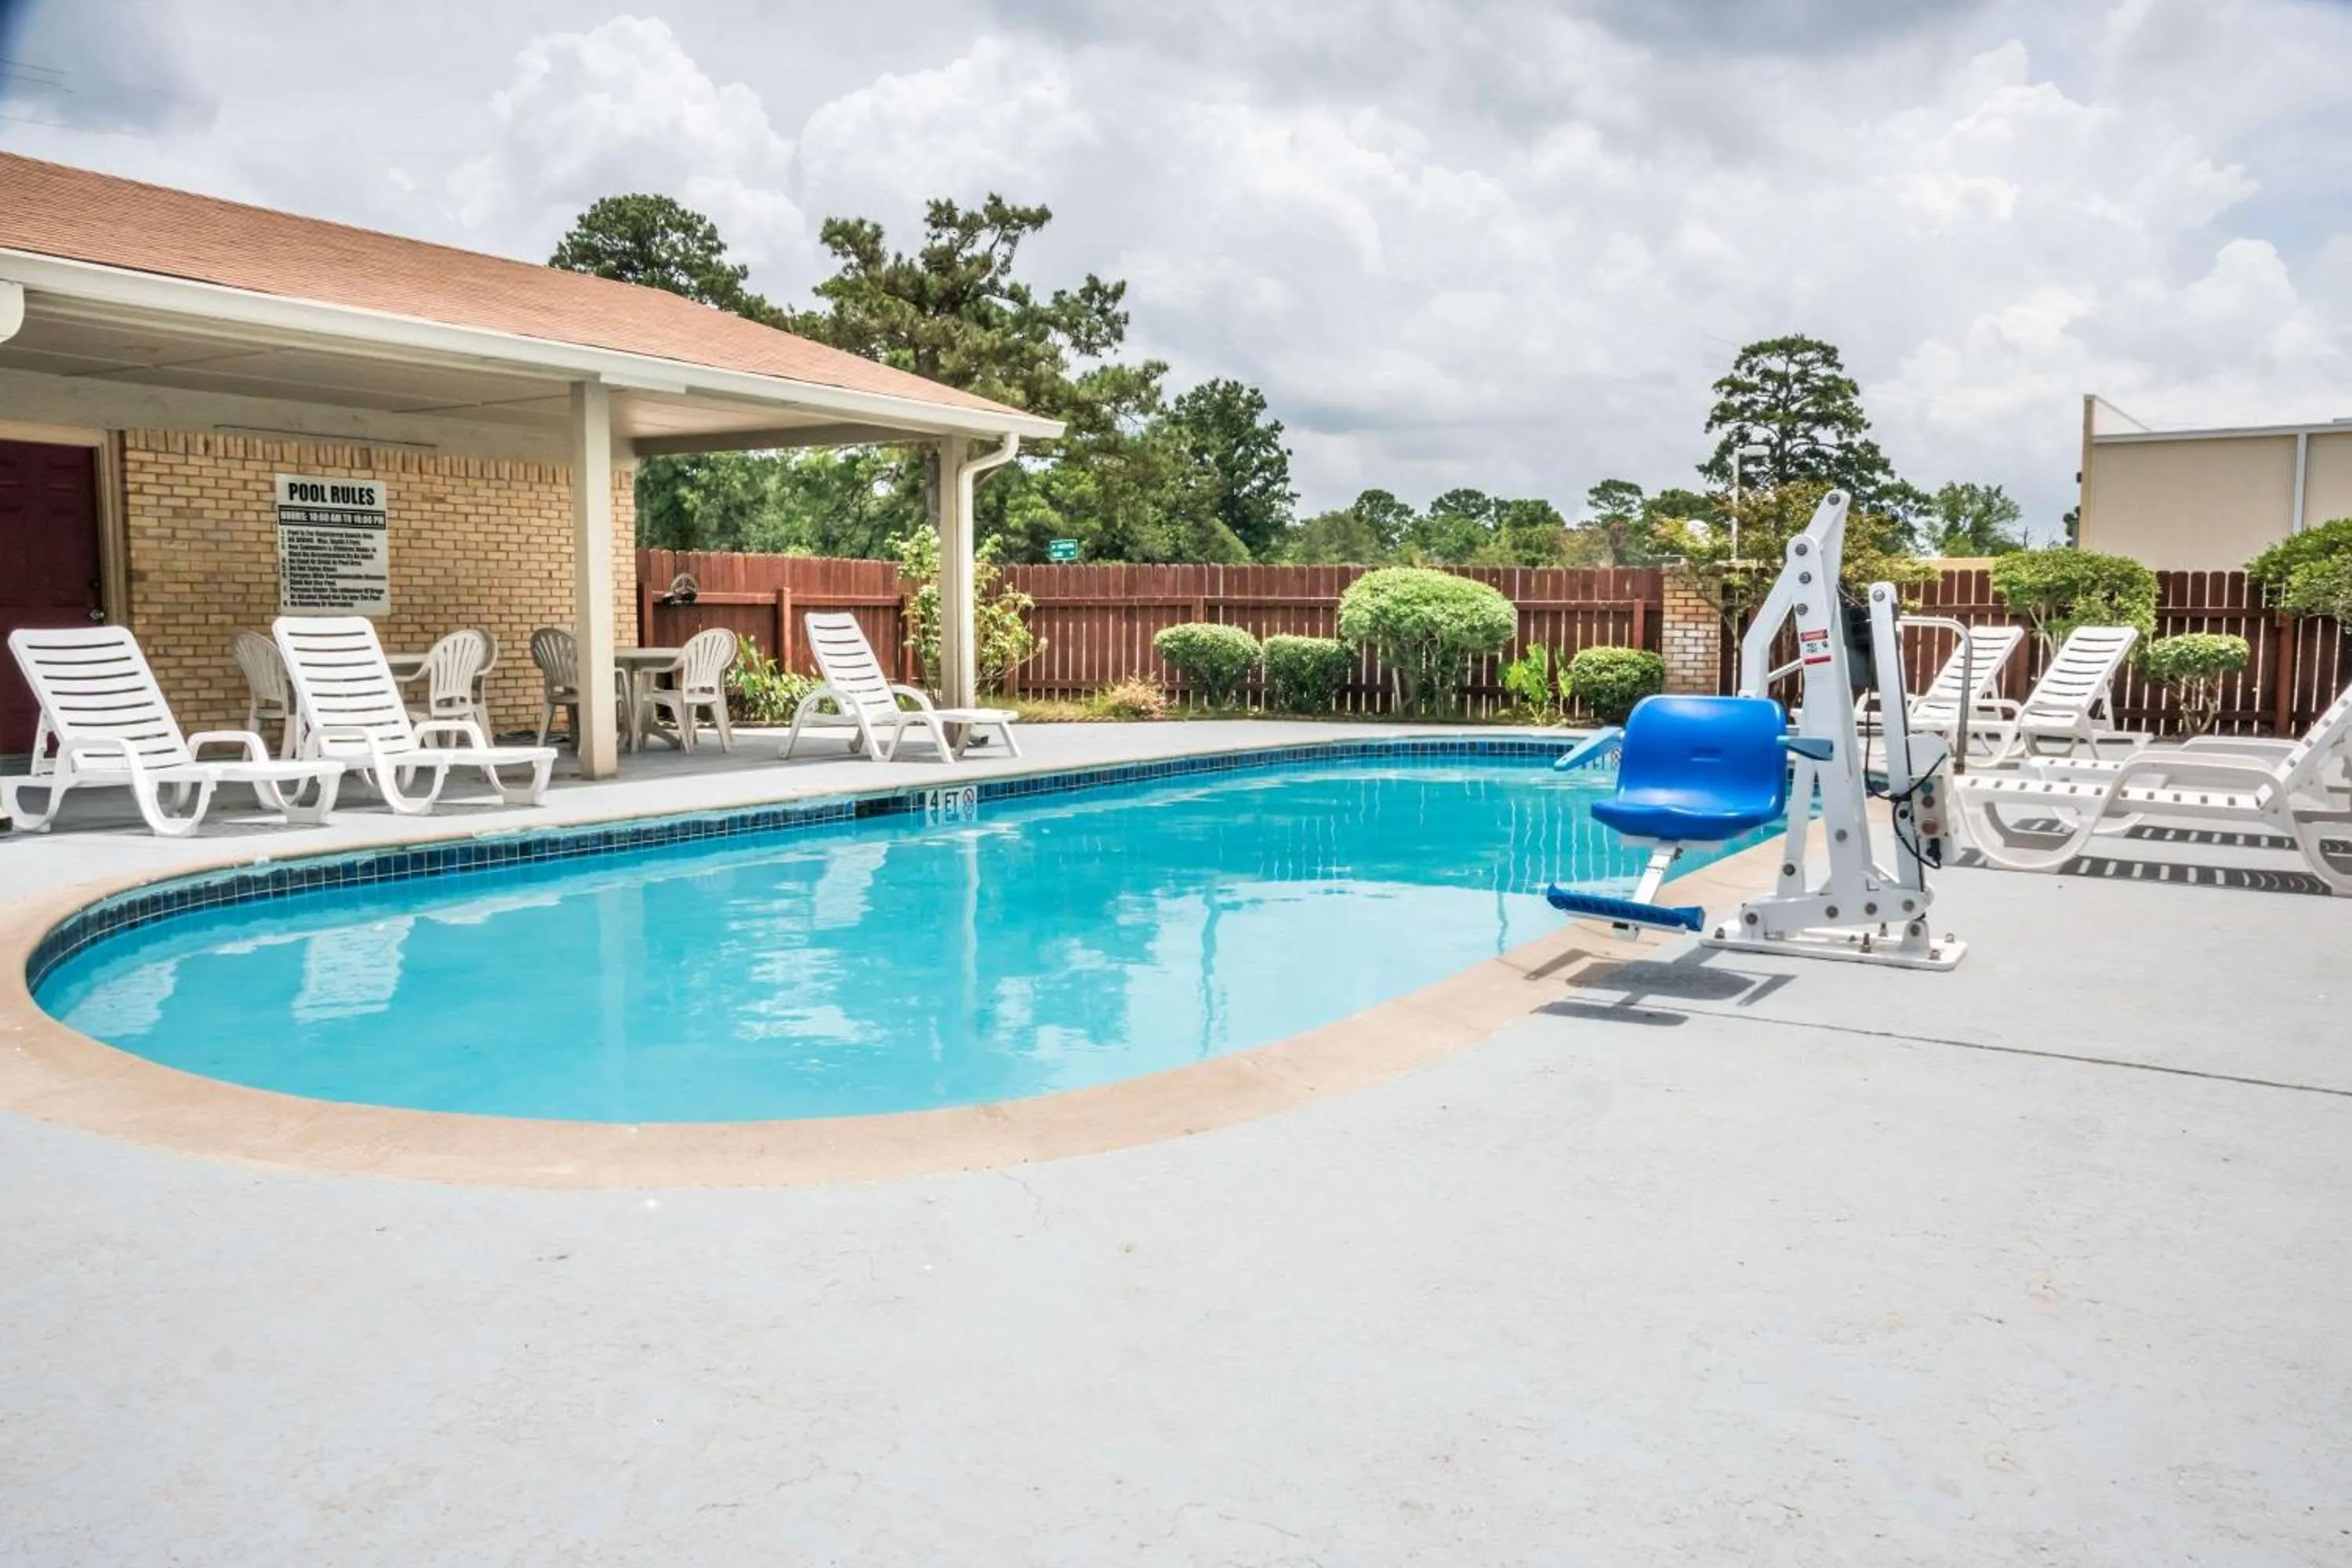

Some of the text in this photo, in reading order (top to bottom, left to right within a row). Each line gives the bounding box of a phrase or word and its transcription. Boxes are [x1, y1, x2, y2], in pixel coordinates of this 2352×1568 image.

[289, 482, 375, 506] POOL RULES
[930, 790, 959, 810] 4 FT
